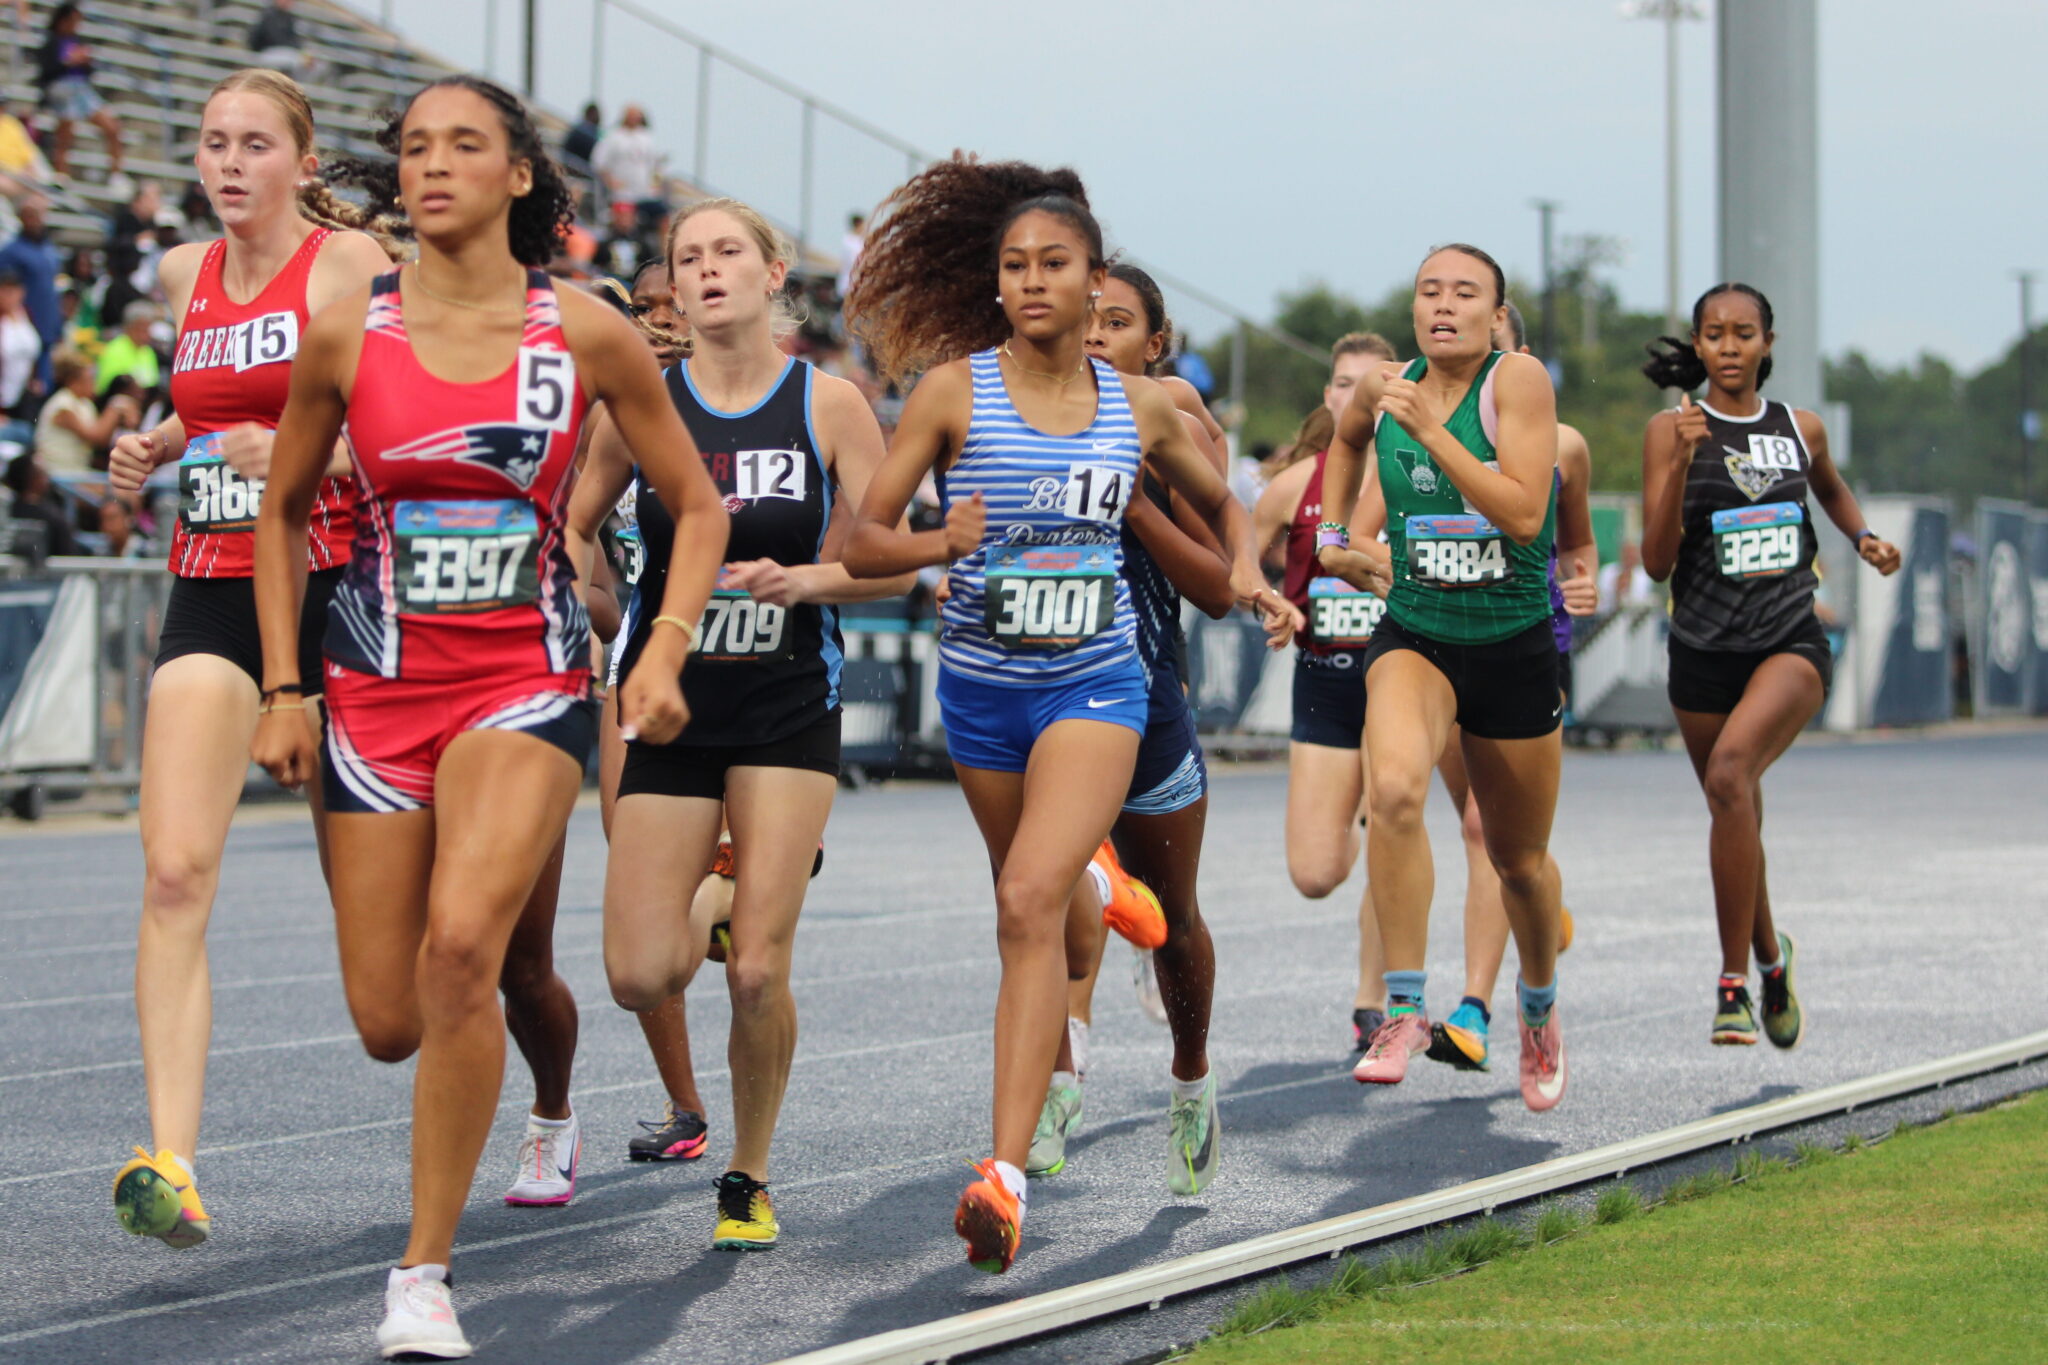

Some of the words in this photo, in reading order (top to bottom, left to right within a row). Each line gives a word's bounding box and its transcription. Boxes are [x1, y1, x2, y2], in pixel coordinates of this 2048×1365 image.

[239, 315, 287, 366] 15
[526, 356, 563, 421] 5
[741, 452, 795, 497] 12
[1753, 437, 1792, 467] 18
[1074, 468, 1121, 520] 14
[406, 535, 531, 602] 3397
[1414, 540, 1507, 584] 3884
[1721, 526, 1800, 575] 3229
[688, 600, 785, 653] 709
[996, 578, 1103, 635] 3001
[1314, 597, 1387, 637] 3659
